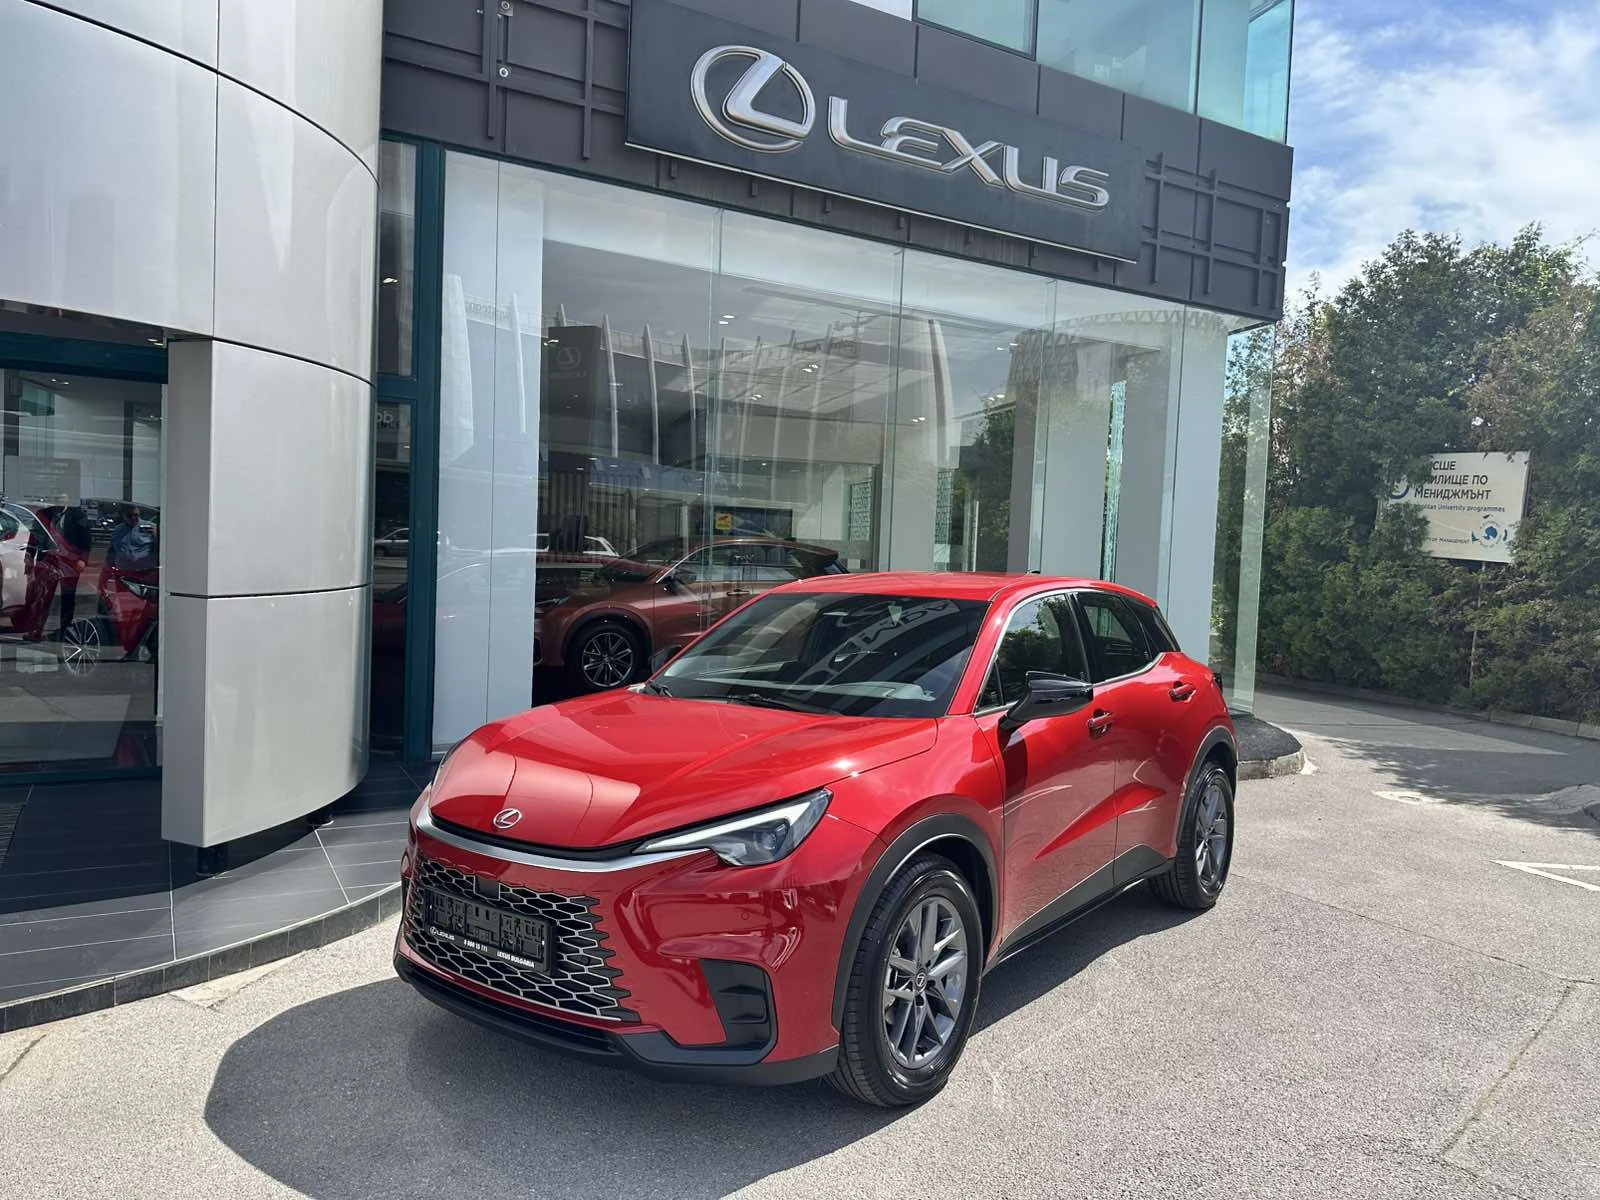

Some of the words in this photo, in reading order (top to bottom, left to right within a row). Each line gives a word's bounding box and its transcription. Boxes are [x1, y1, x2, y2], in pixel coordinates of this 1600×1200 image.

[827, 95, 1110, 210] LEXUS
[1432, 460, 1457, 471] СШЕ
[1431, 474, 1469, 487] ИЛИЩЕ
[1472, 474, 1489, 486] ПО
[497, 950, 511, 961] LEXUS
[511, 955, 535, 969] BULGARIA
